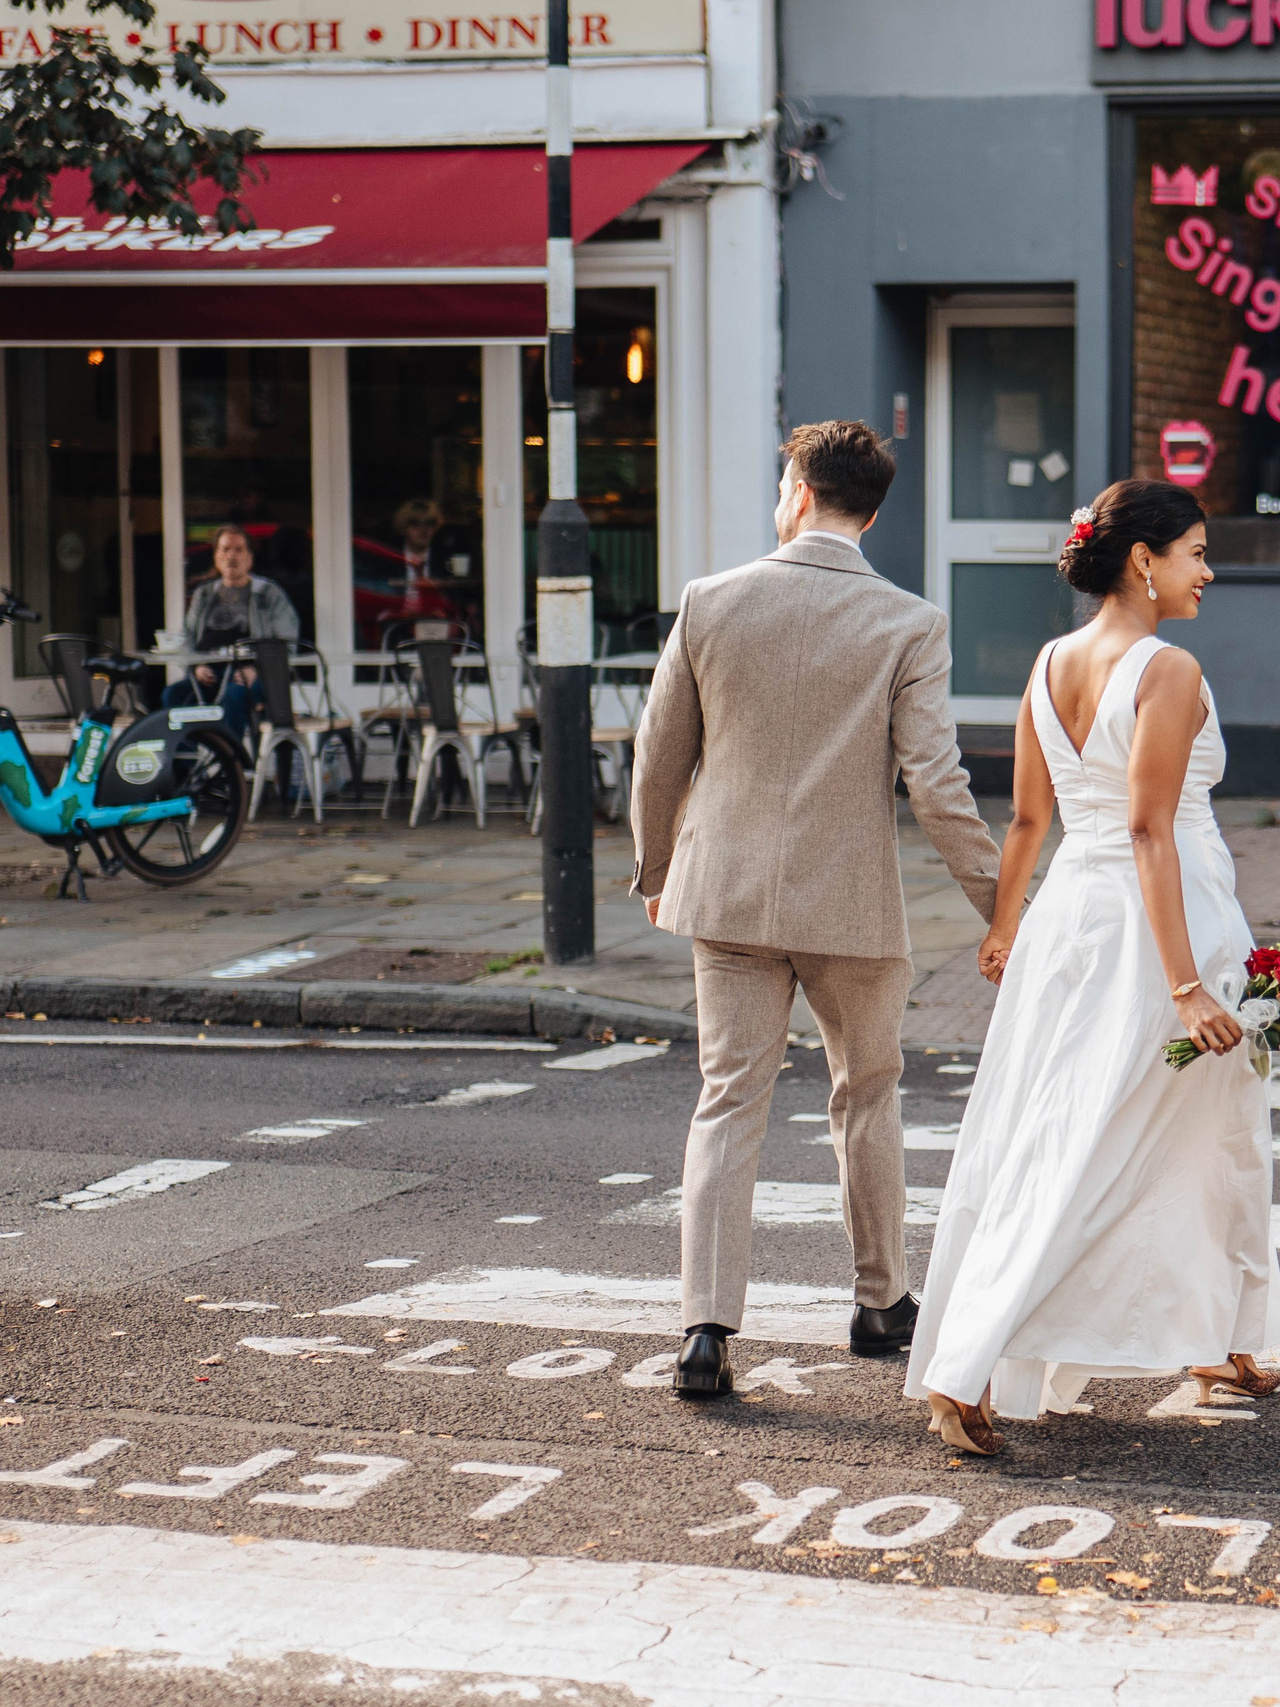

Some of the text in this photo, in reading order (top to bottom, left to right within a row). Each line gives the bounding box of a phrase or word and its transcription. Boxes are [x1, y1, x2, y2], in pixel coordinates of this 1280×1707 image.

[0, 15, 613, 57] FAT LUNCH DINNR
[0, 1438, 1272, 1575] LOOK LEFT
